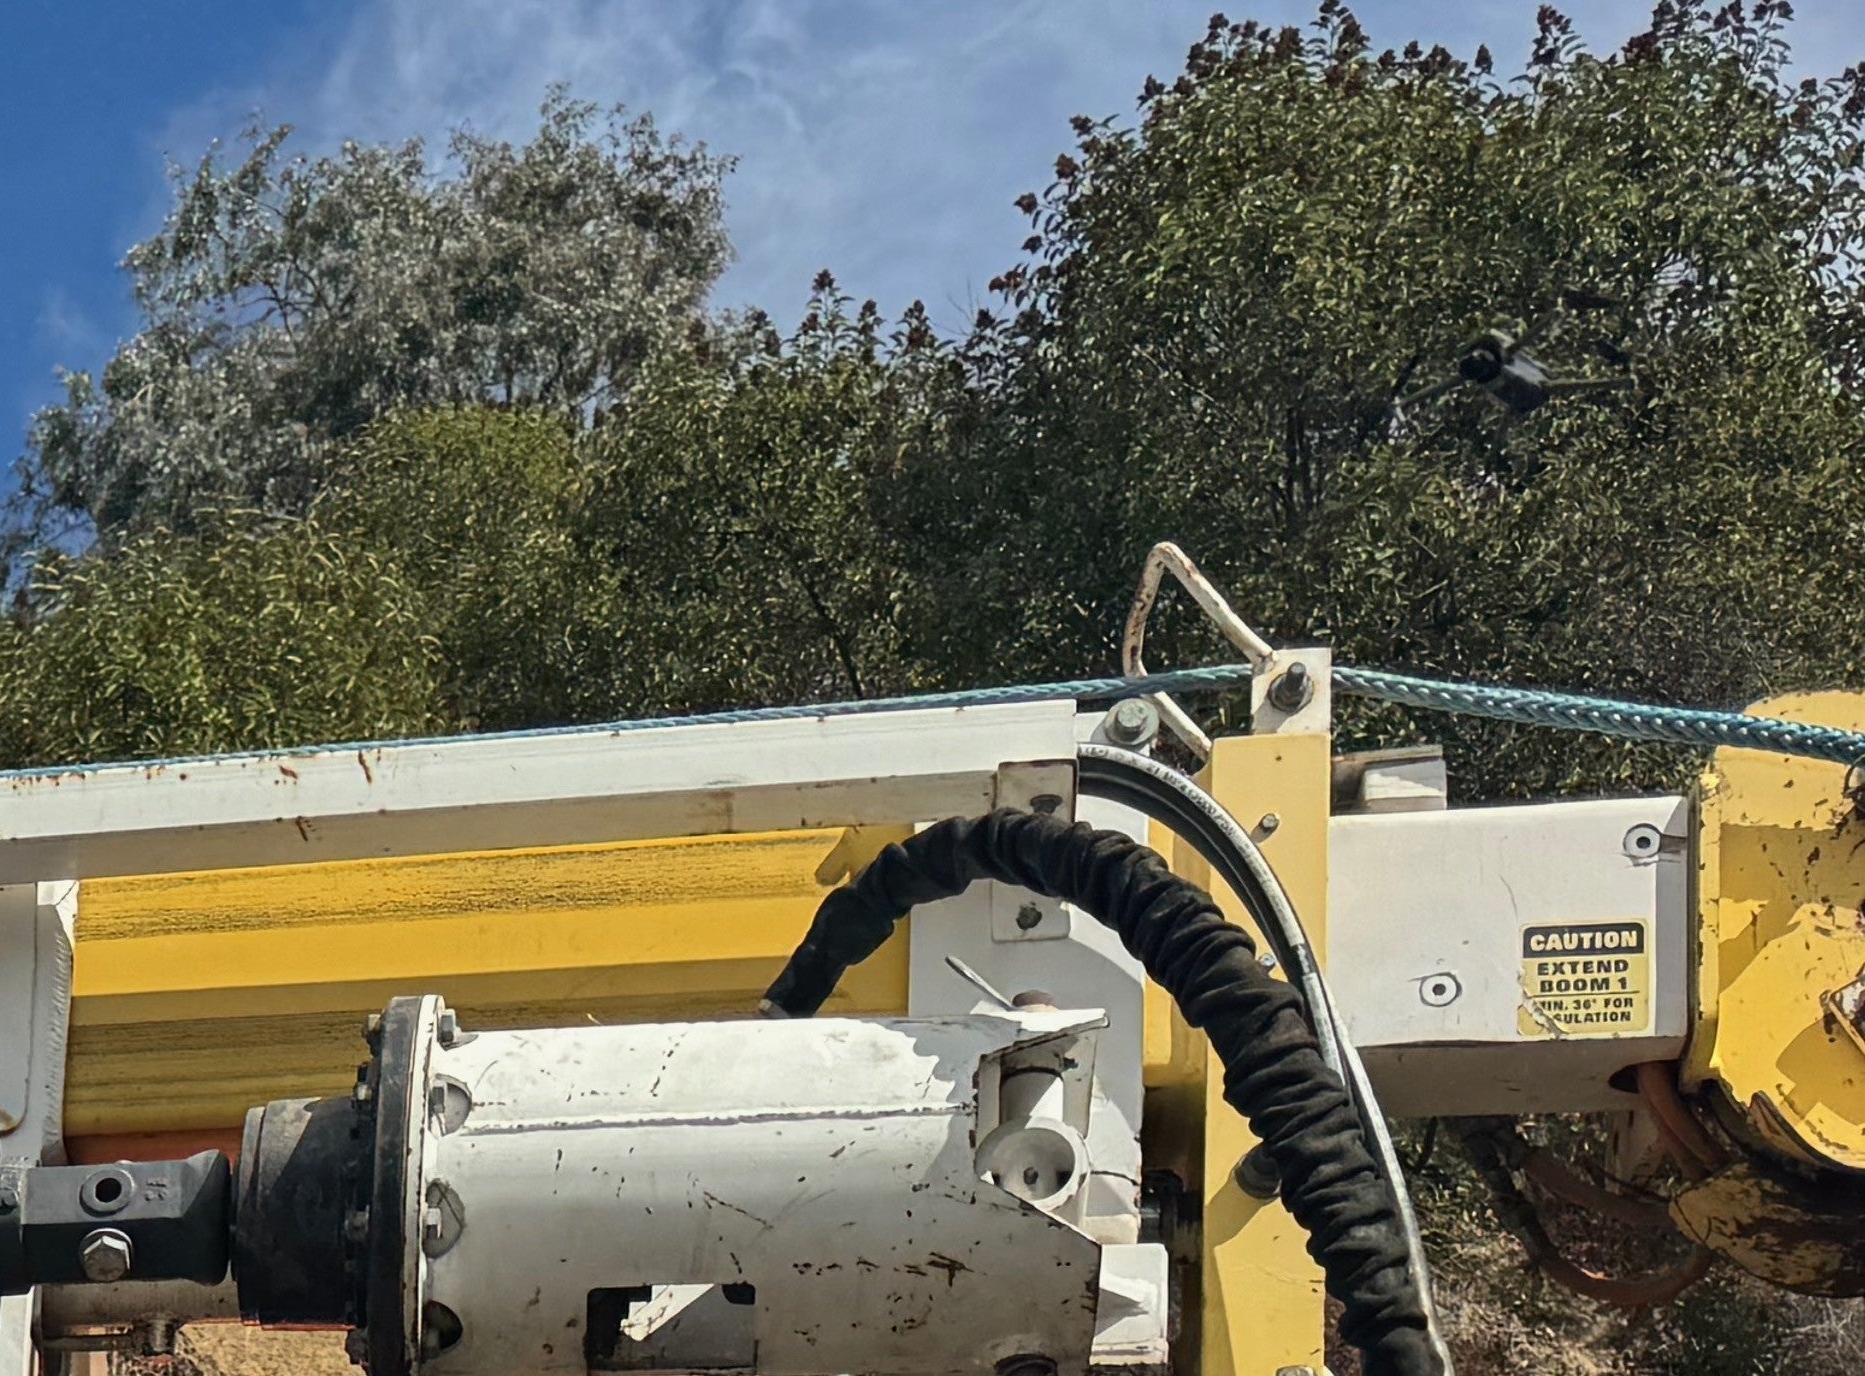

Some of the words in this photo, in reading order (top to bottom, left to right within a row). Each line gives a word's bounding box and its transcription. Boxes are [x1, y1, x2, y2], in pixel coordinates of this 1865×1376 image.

[1530, 930, 1638, 951] CAUTION
[1537, 959, 1630, 976] EXTEND
[1539, 977, 1610, 993] BOOM
[1617, 976, 1628, 990] 1
[1603, 997, 1634, 1008] FOR
